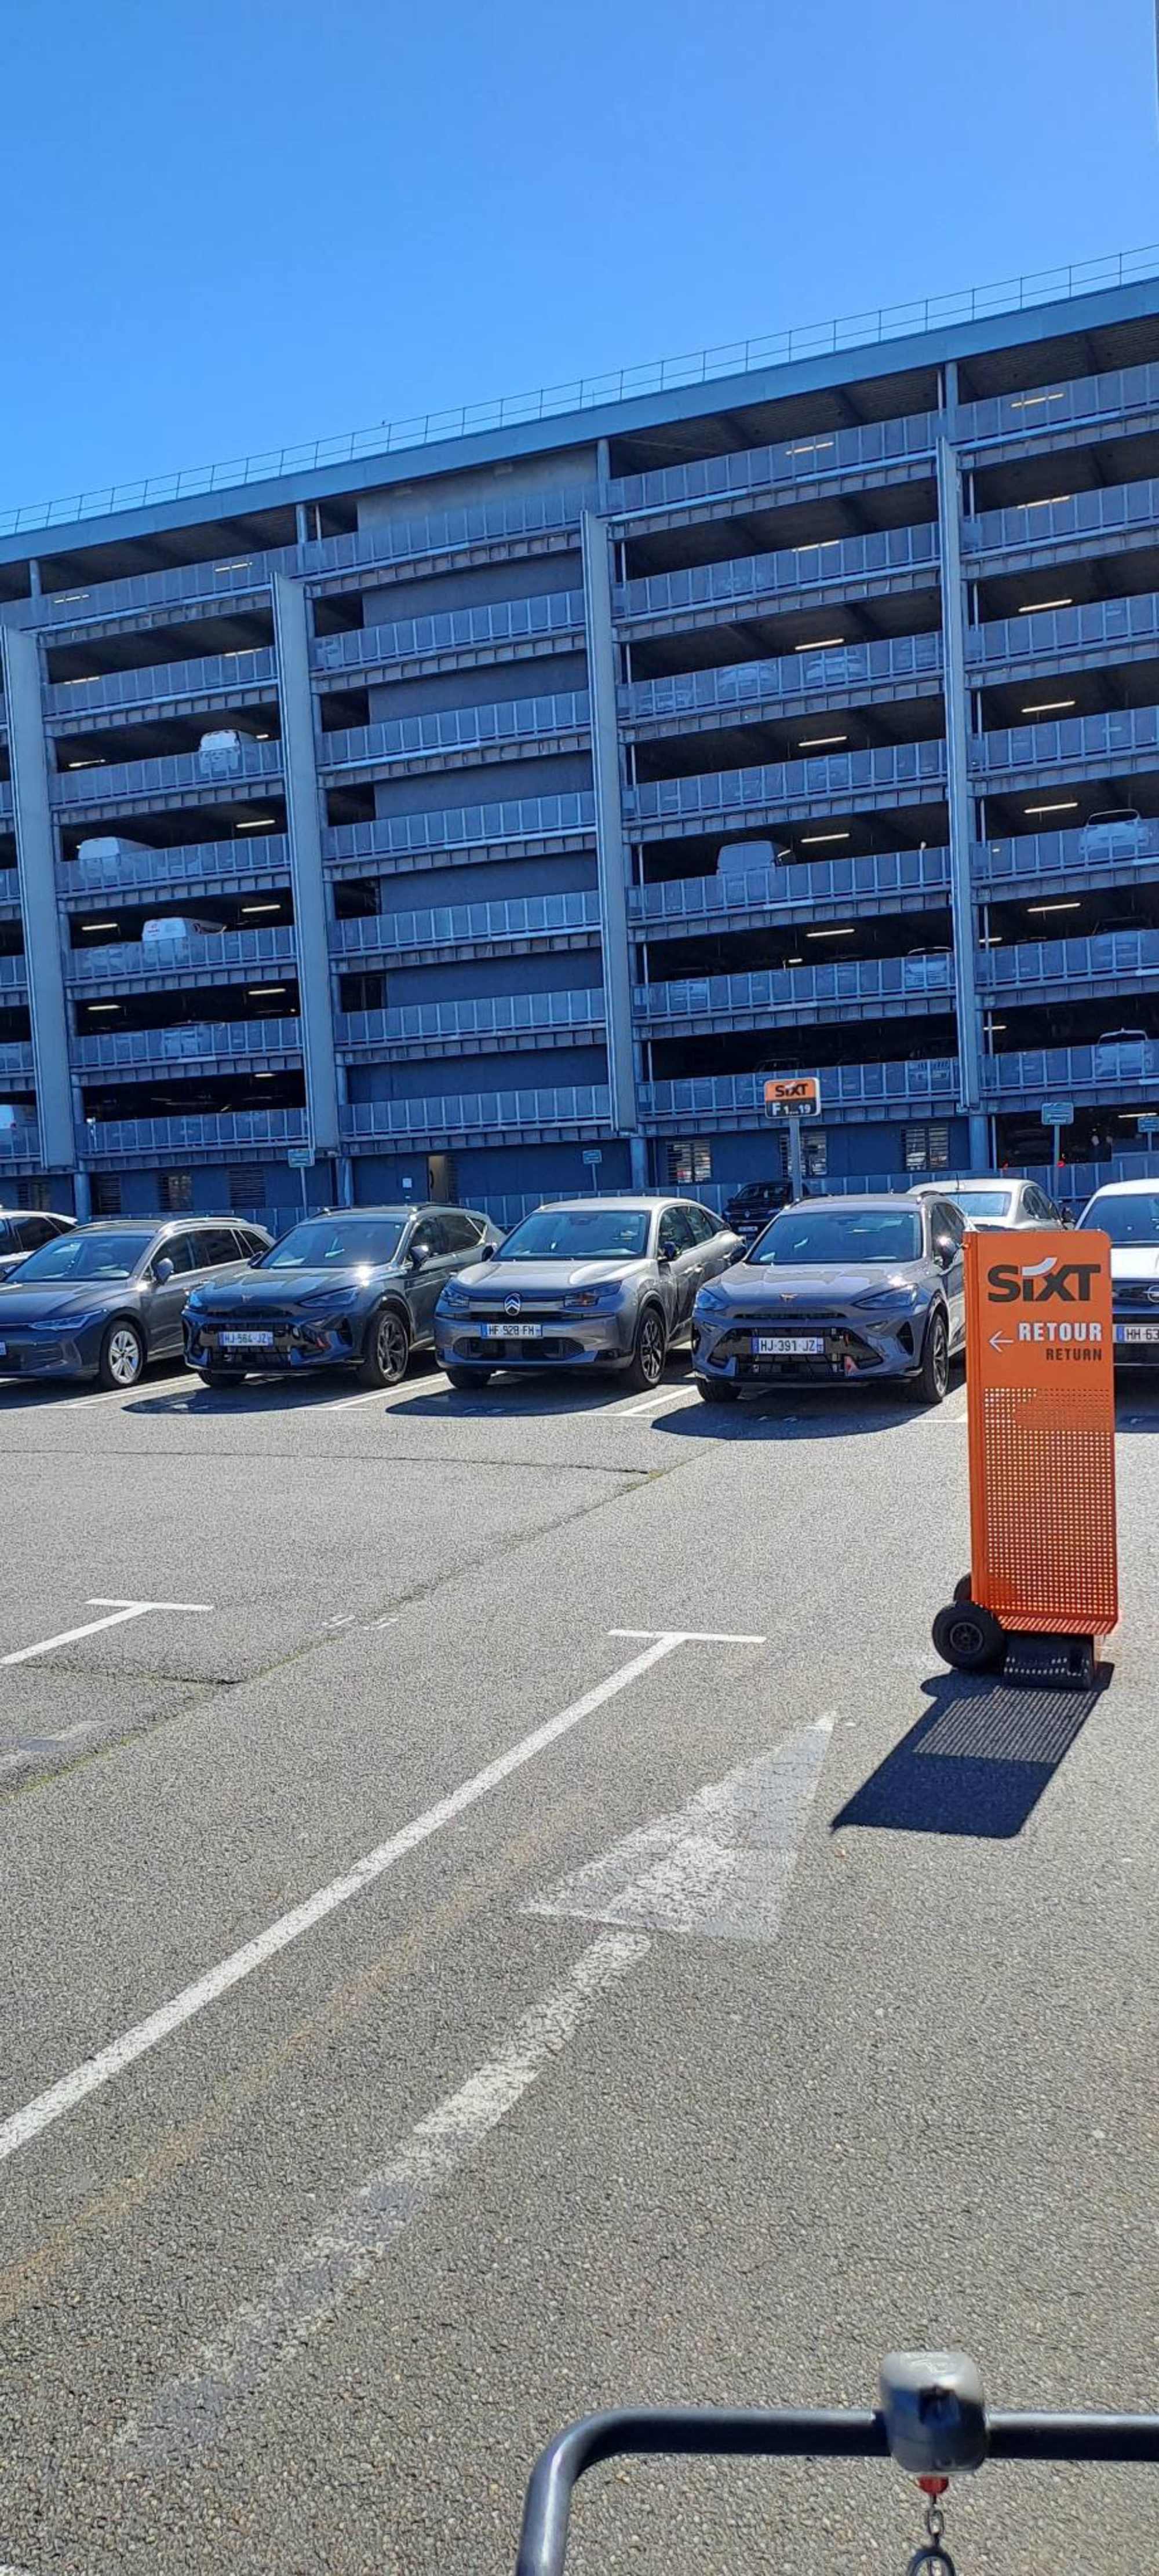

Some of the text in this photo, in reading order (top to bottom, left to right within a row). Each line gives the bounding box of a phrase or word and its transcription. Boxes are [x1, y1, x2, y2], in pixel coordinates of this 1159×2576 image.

[772, 1102, 781, 1116] F
[1019, 1322, 1102, 1342] RETOUR
[1046, 1348, 1102, 1361] RETURN
